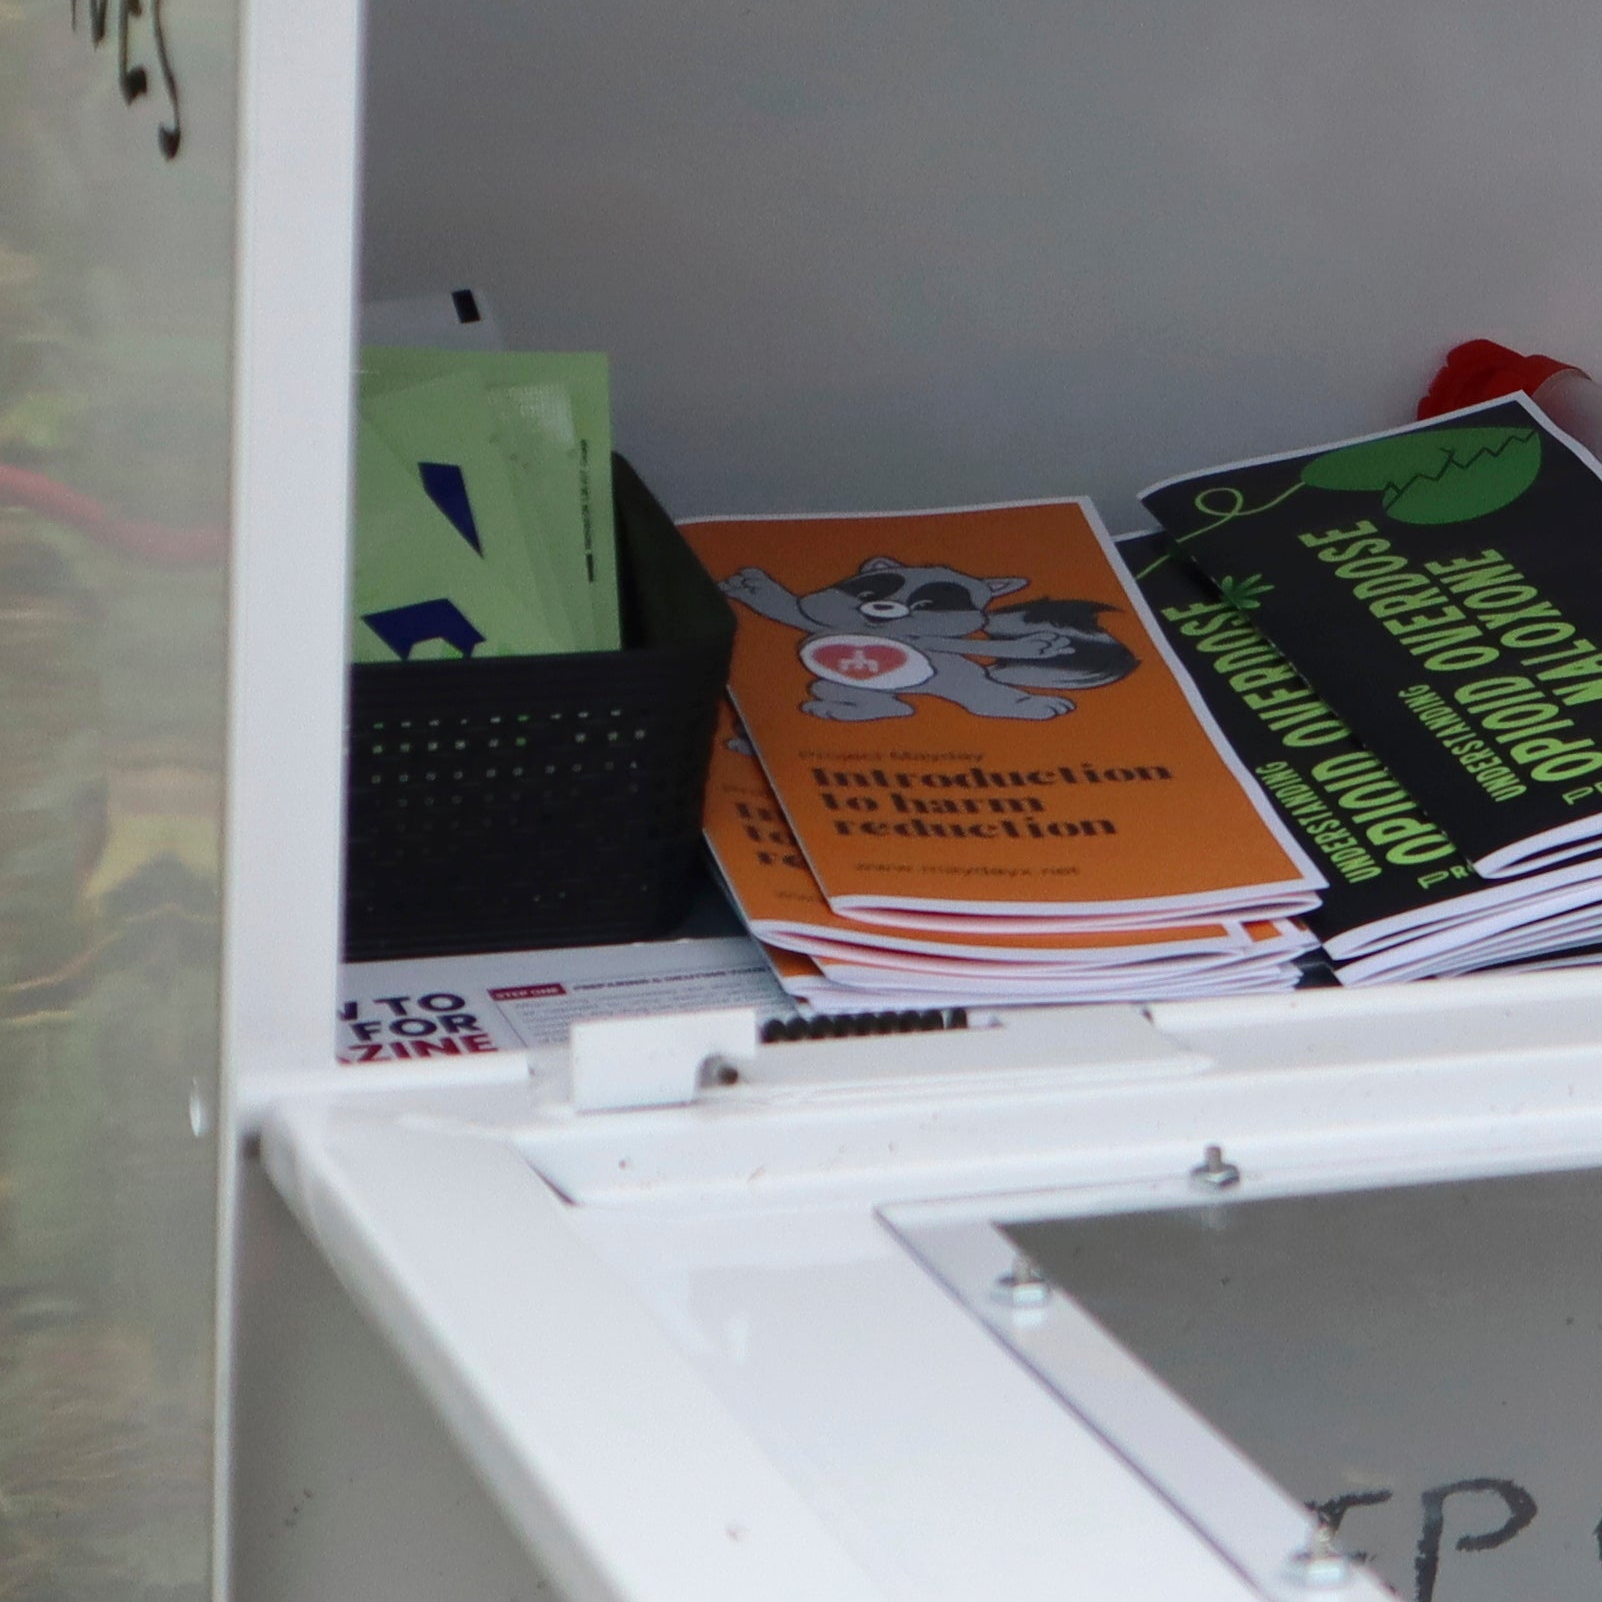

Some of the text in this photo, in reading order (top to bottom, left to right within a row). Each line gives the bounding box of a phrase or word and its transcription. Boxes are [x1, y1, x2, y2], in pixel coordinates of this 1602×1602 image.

[1298, 520, 1500, 671] OVERDOSE
[1161, 602, 1456, 864] OPIOID OVERDOSE
[1398, 684, 1527, 802] UNDERSTANDING
[811, 761, 1173, 789] Introduction
[820, 792, 1045, 815] to harm
[833, 815, 1119, 839] reduction
[1255, 761, 1382, 883] UNDERSTANDING
[373, 993, 466, 1016] TO
[349, 1013, 482, 1042] FOR
